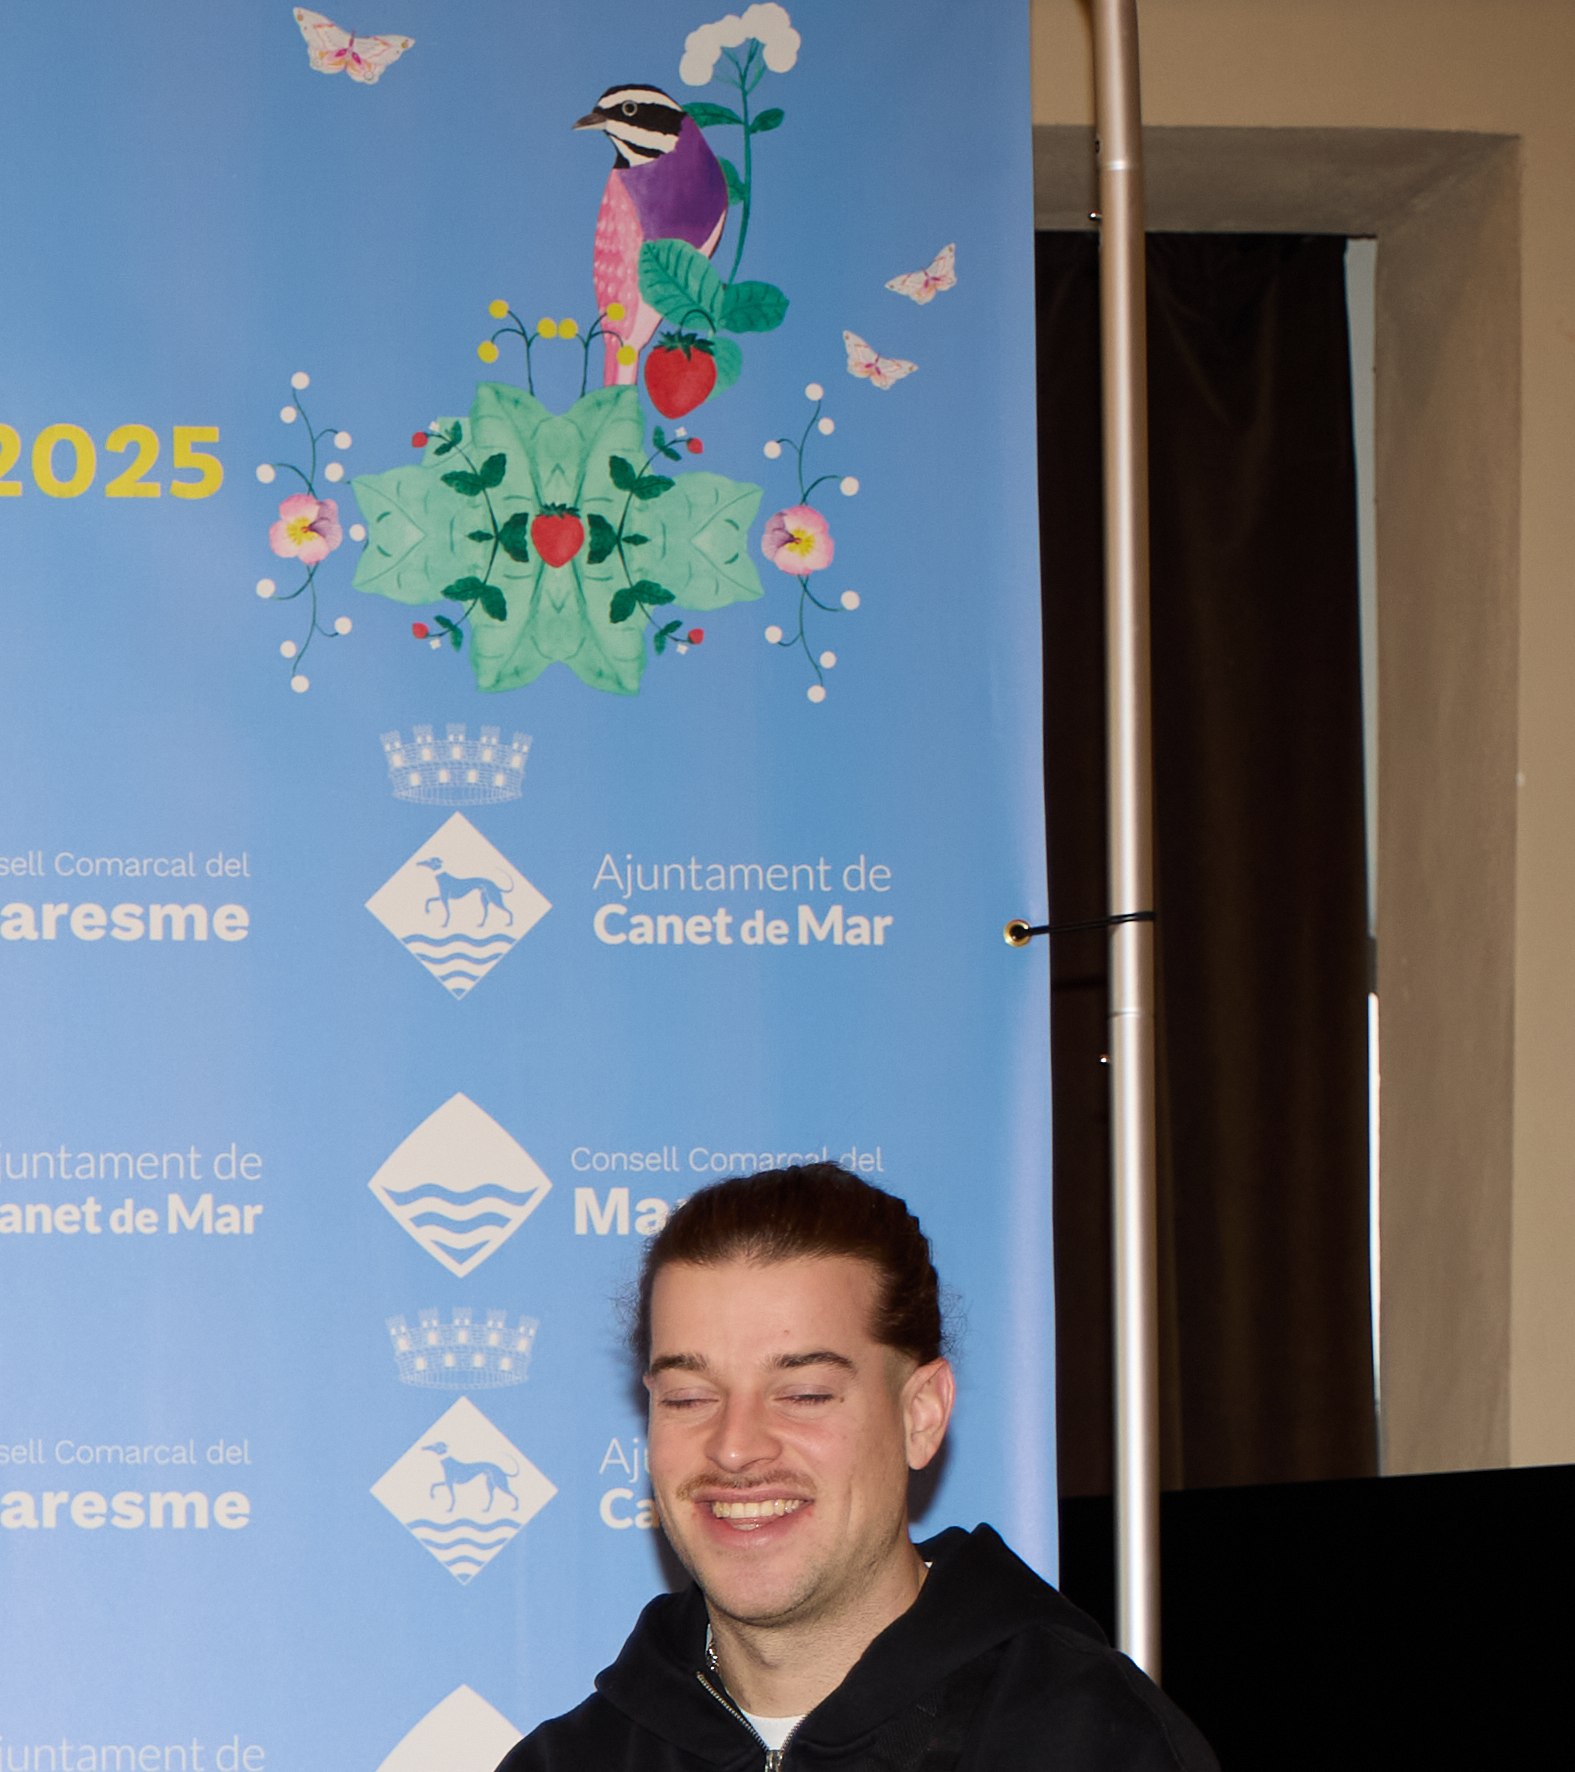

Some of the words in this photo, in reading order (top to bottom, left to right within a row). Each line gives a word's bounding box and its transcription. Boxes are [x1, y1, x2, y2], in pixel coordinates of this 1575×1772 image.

[54, 852, 196, 877] Comarcal
[205, 852, 250, 877] del
[593, 854, 831, 894] Ajuntament
[843, 855, 891, 892] de
[594, 904, 732, 944] Canet
[741, 910, 789, 944] de
[799, 905, 893, 945] Mar
[214, 1143, 262, 1180] de
[571, 1146, 678, 1172] Consell
[838, 1146, 885, 1172] del
[110, 1199, 158, 1233] de
[169, 1194, 263, 1234] Mar
[55, 1439, 196, 1465] Comarcal
[206, 1439, 251, 1464] del
[216, 1735, 265, 1772] de
